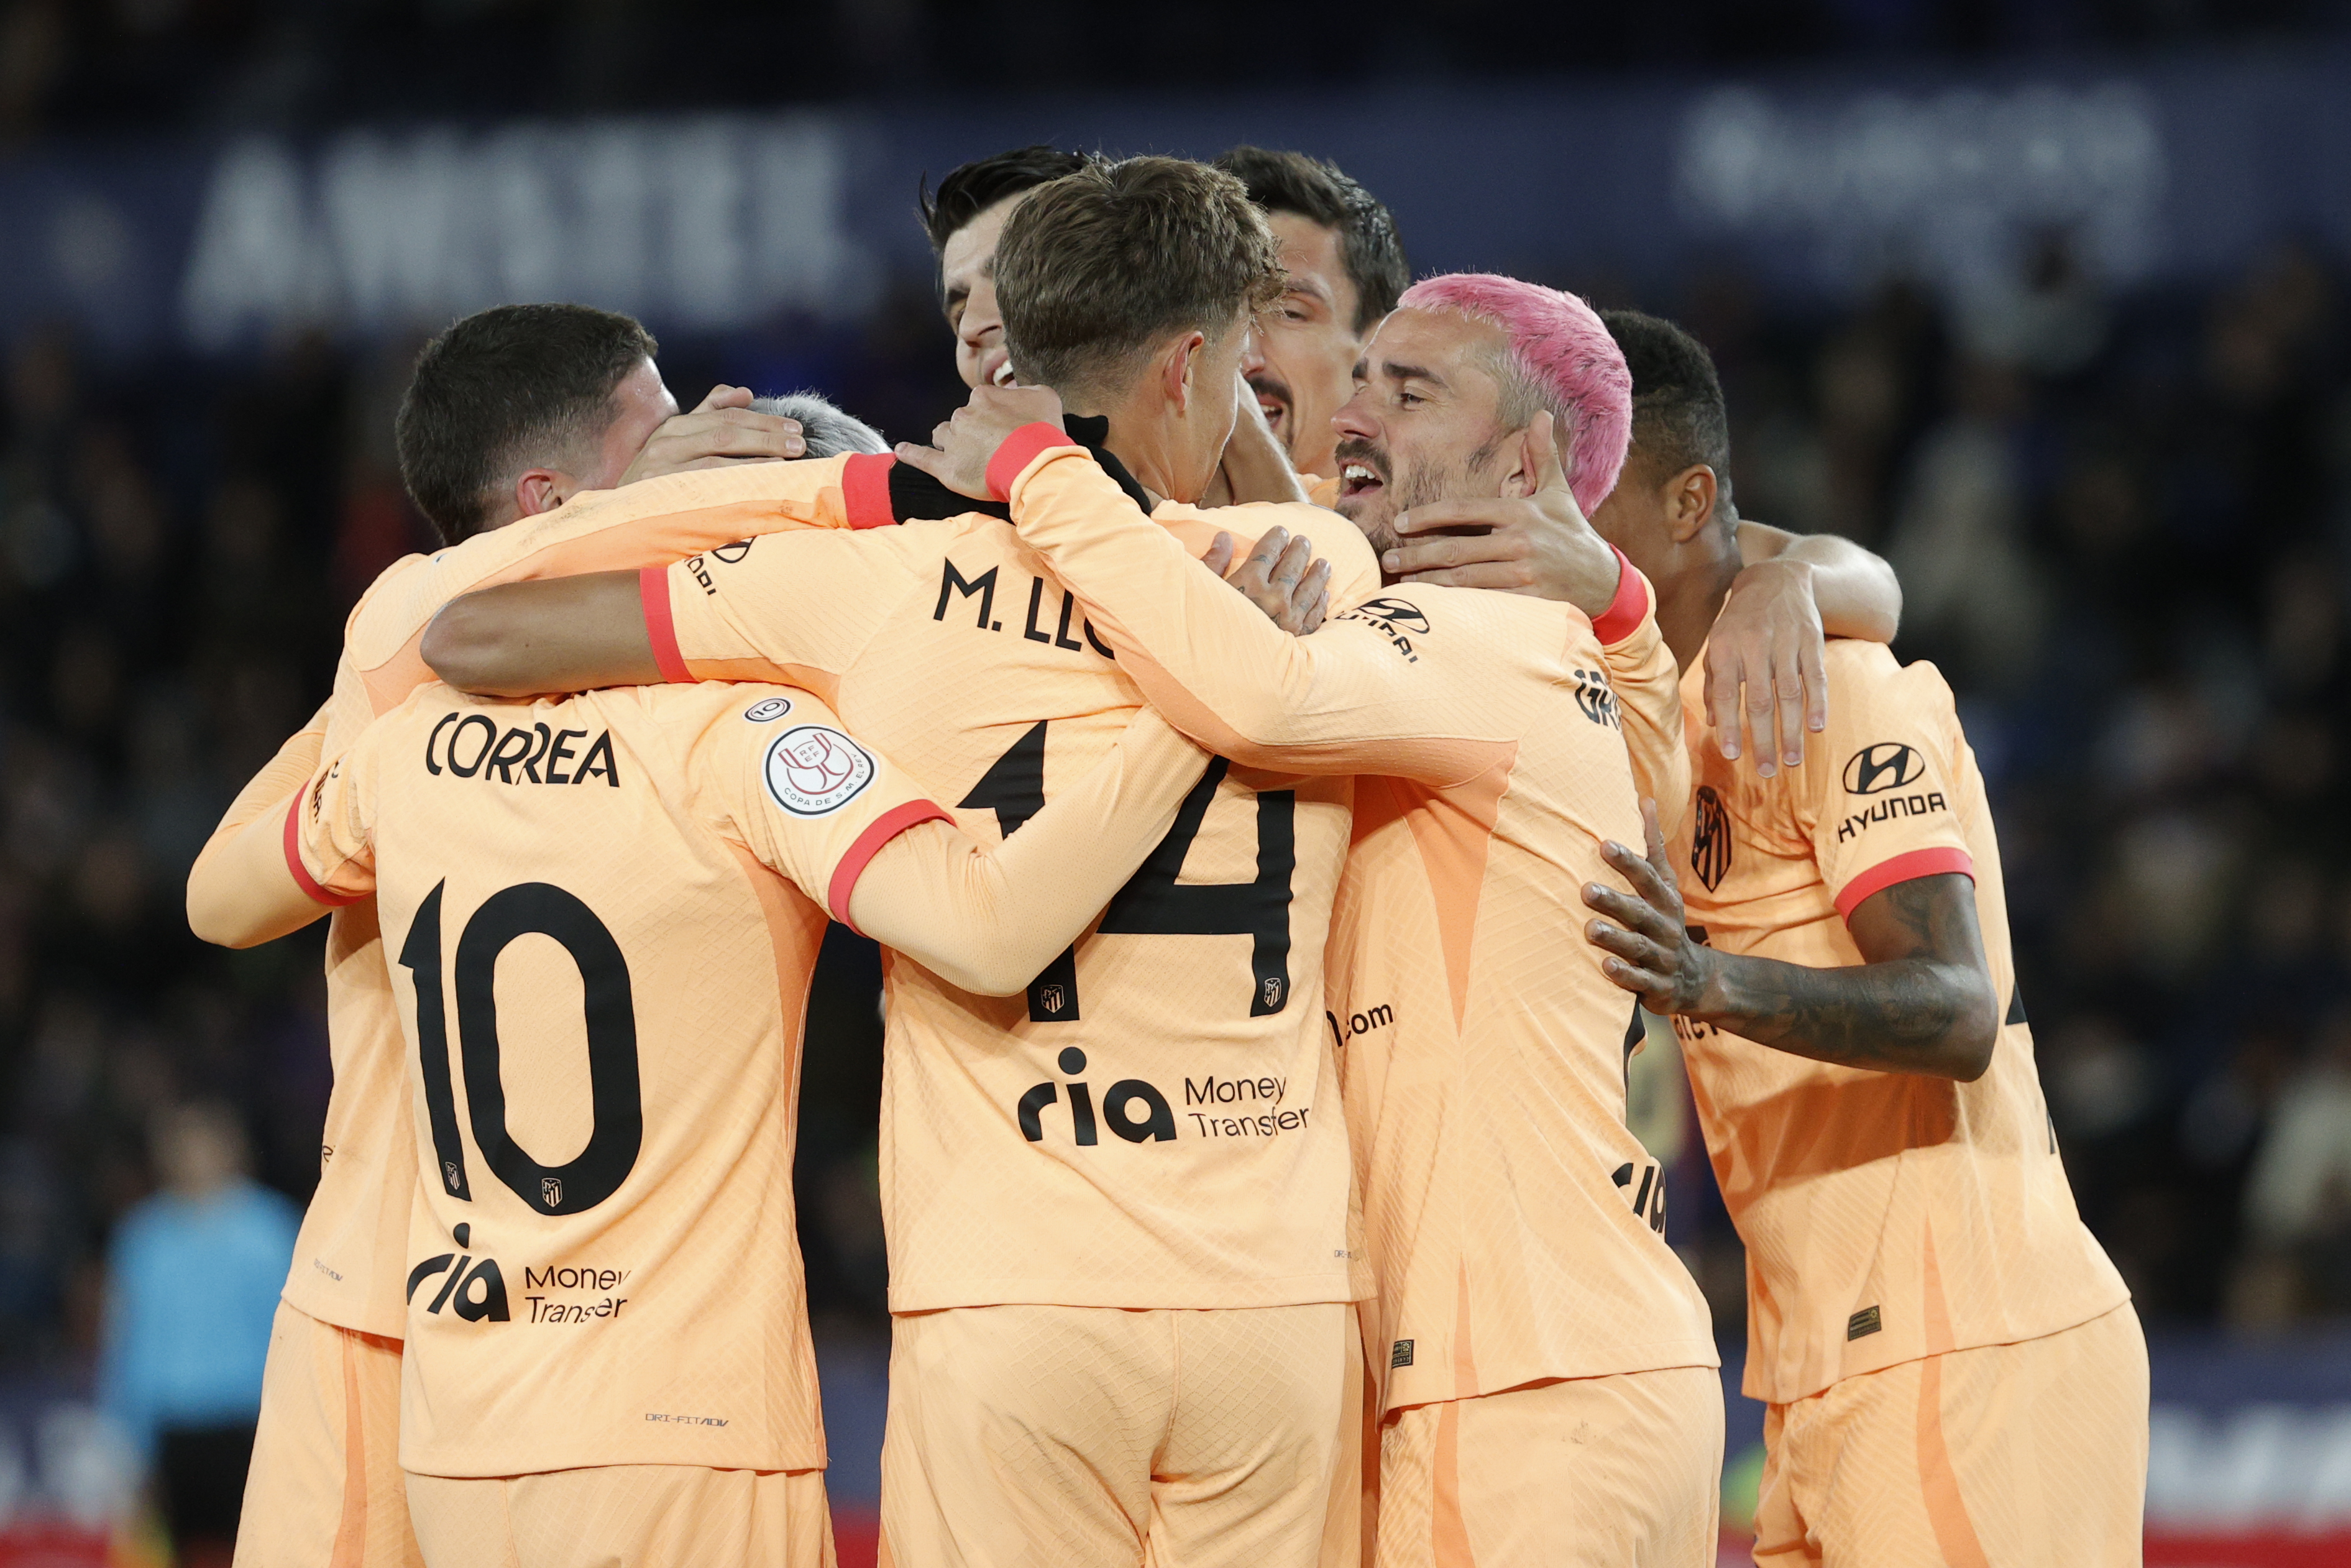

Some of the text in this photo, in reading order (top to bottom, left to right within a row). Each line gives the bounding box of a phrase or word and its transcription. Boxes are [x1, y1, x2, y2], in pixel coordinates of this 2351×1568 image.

[933, 556, 1002, 632] M.
[753, 702, 781, 716] 10
[426, 712, 620, 787] CORREA
[784, 787, 810, 806] COPA
[815, 797, 832, 806] DE
[1838, 792, 1947, 844] HYUNDA
[956, 719, 1295, 1021] 14
[398, 875, 643, 1216] 10
[1017, 1046, 1178, 1146] ria
[1185, 1075, 1287, 1105] Money
[1188, 1106, 1310, 1139] Transfer
[406, 1222, 511, 1323] ria
